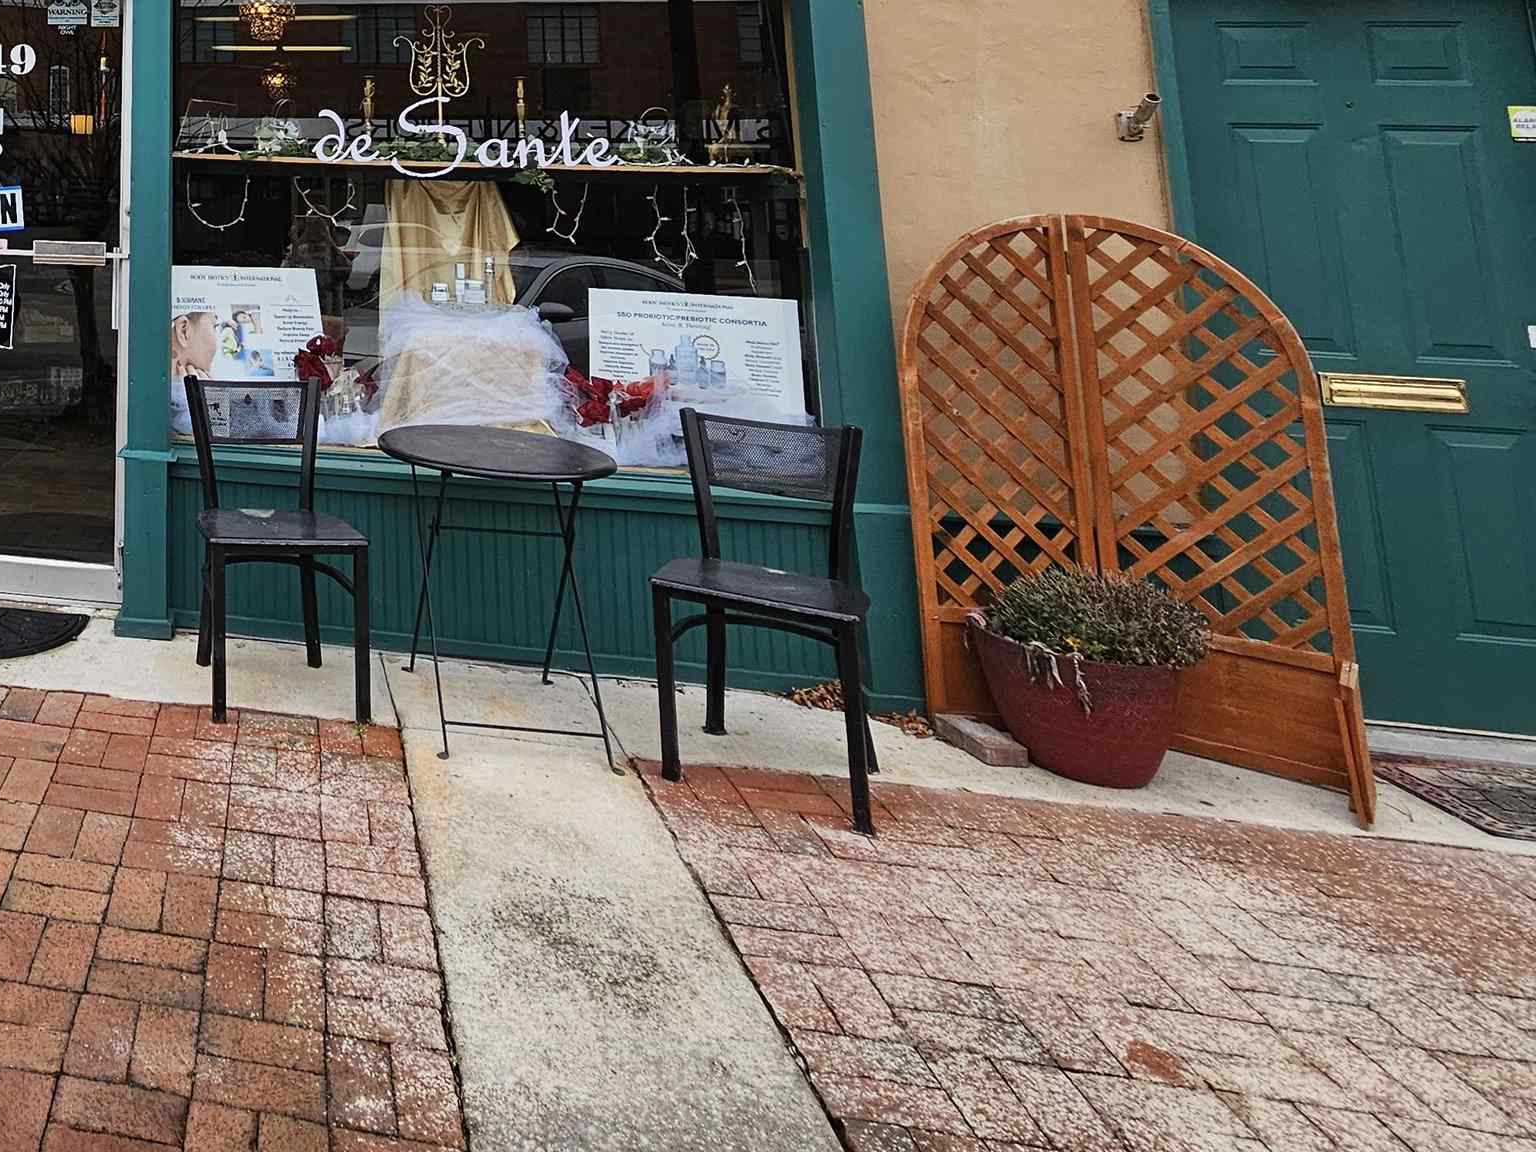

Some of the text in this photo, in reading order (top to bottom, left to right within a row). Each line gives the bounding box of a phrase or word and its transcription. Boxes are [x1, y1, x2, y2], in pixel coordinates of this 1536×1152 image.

[48, 8, 87, 16] WARNING
[312, 109, 383, 163] de
[719, 317, 768, 327] CONSORTIA
